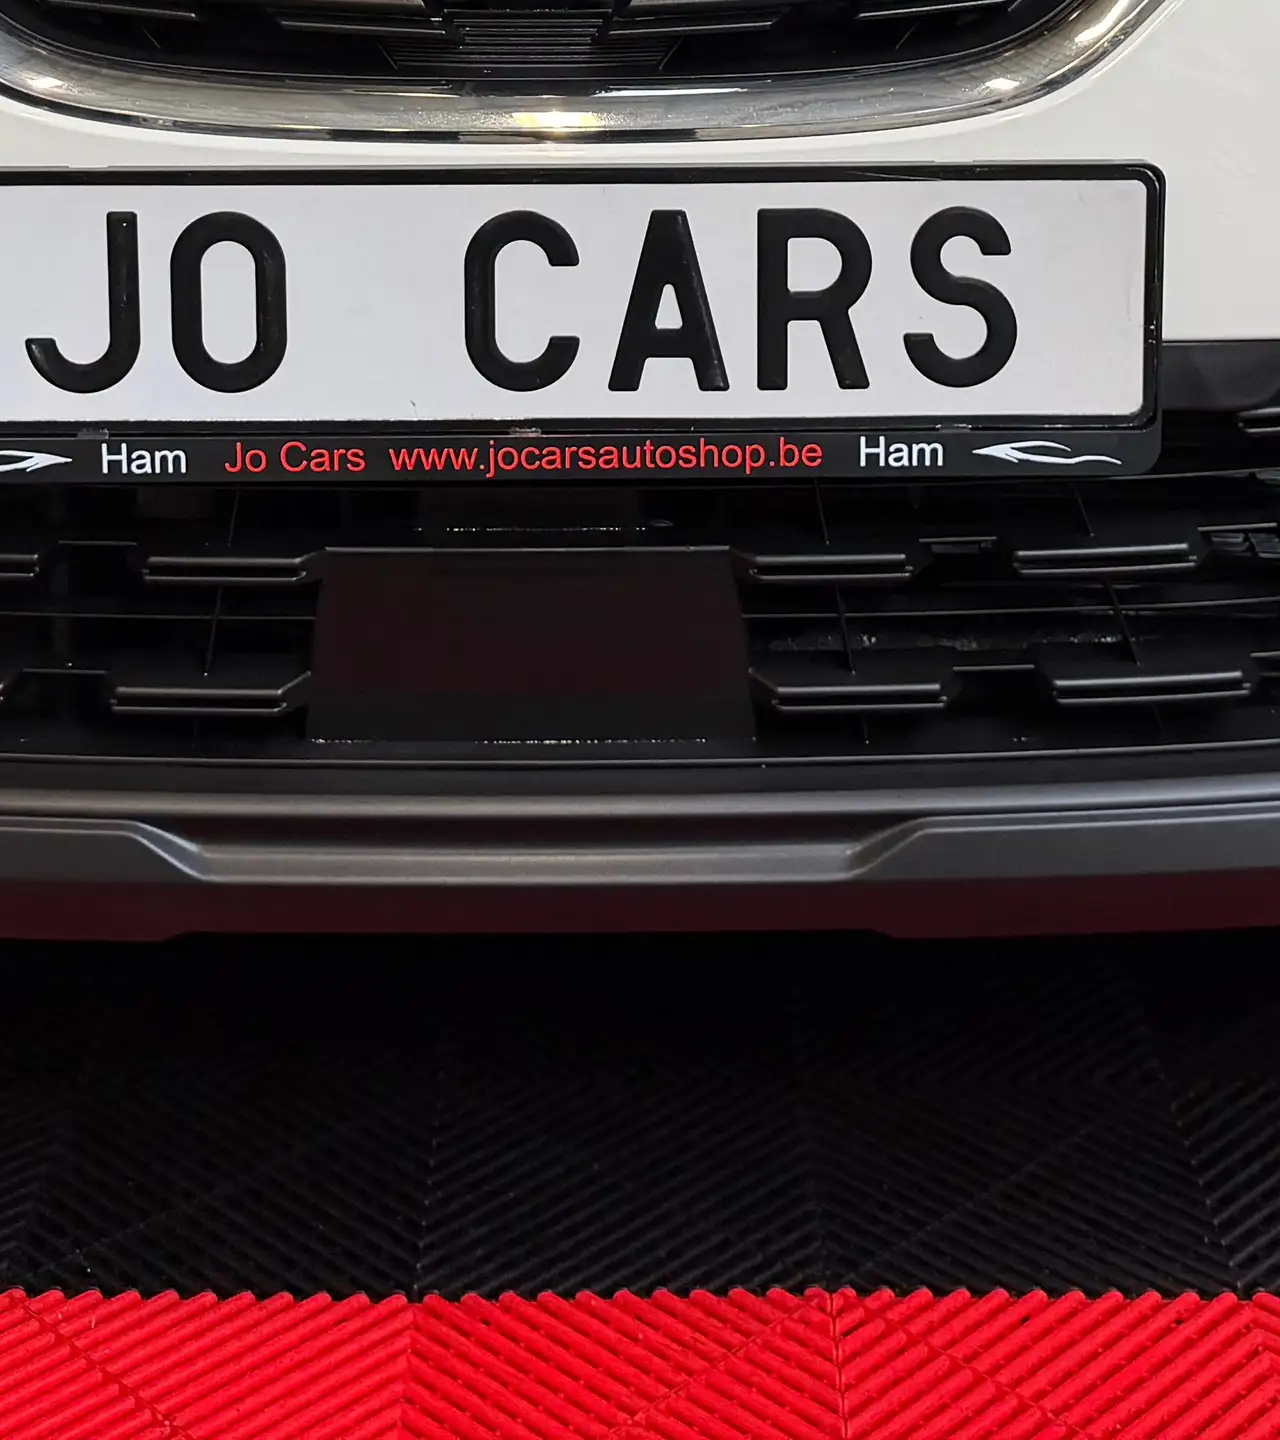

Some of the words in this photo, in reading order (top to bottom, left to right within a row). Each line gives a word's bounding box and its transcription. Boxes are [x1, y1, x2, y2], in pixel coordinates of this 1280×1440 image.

[24, 210, 288, 394] JO
[463, 206, 1018, 393] CARS
[101, 442, 187, 474] Ham
[224, 442, 268, 473] Jo
[280, 440, 367, 473] Cars
[389, 437, 823, 479] www.jocarsautoshop.be
[859, 435, 944, 468] Ham
